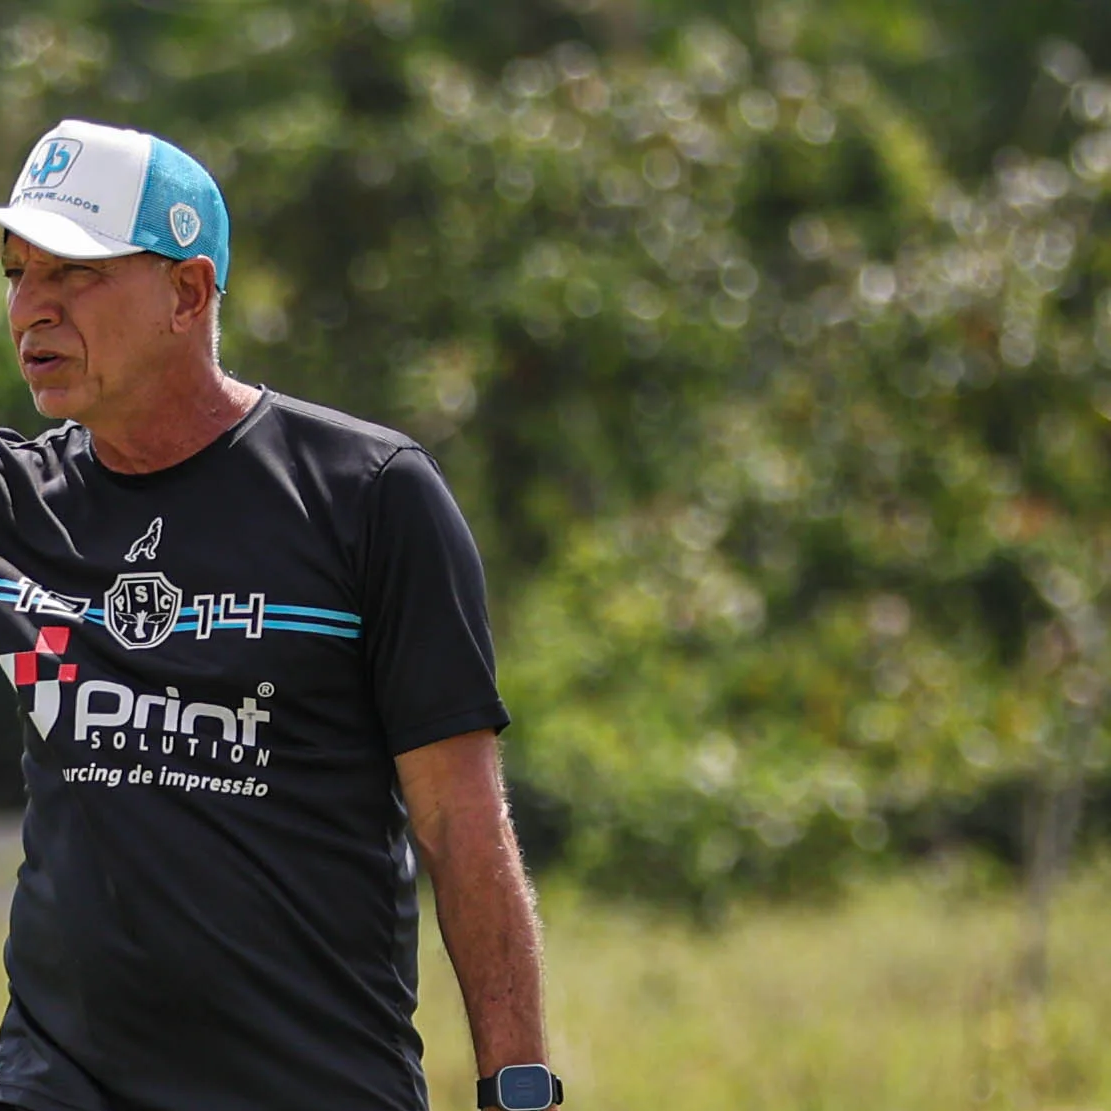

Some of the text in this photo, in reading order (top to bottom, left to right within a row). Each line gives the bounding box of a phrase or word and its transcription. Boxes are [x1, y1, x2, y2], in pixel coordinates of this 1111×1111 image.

[192, 592, 266, 640] 14
[90, 730, 271, 767] SOLUTION
[127, 764, 154, 784] de
[158, 766, 269, 797] impressão
